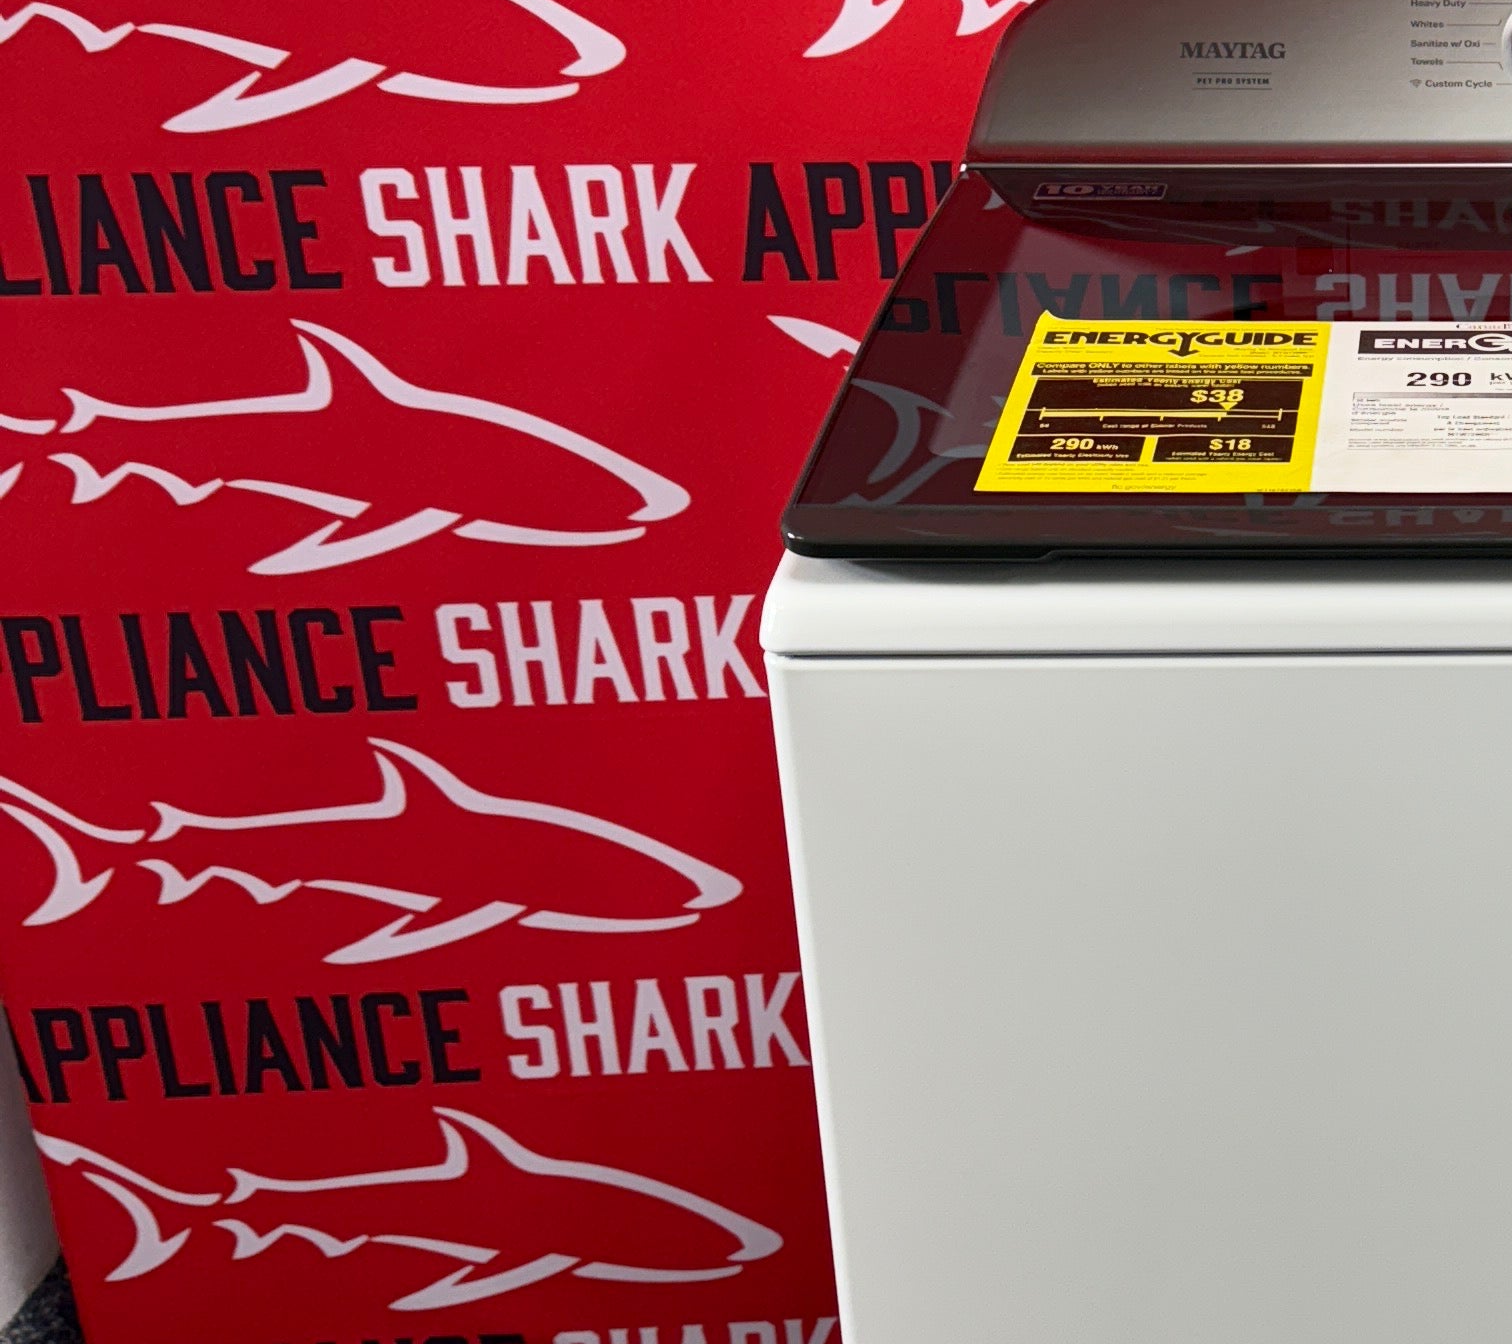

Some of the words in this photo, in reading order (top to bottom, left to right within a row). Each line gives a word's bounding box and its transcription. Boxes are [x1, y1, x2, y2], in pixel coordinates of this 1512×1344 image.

[1411, 0, 1440, 8] Heavy
[1443, 0, 1466, 8] Duty
[1411, 20, 1444, 28] Whites
[1410, 39, 1448, 48] Sanitize
[1450, 40, 1462, 48] w/
[1464, 40, 1480, 48] Oxi
[1179, 41, 1287, 59] MAYTAG
[1411, 58, 1443, 66] Towels
[1197, 77, 1212, 85] PET
[1215, 77, 1233, 85] PRO
[1236, 77, 1270, 85] SYSTEM
[1425, 79, 1463, 88] Custom
[1465, 79, 1492, 89] Cycle
[1047, 185, 1096, 195] 10
[0, 170, 343, 297] IANCE
[359, 163, 713, 288] SHARK
[1043, 331, 1318, 350] ENERGYGUIDE
[1406, 372, 1472, 387] 290
[1190, 389, 1244, 403] $38
[1050, 438, 1094, 450] 290
[1209, 439, 1251, 450] $18
[0, 606, 418, 724] PLIANCE
[436, 594, 768, 709] SHARK
[499, 971, 811, 1080] SHARK
